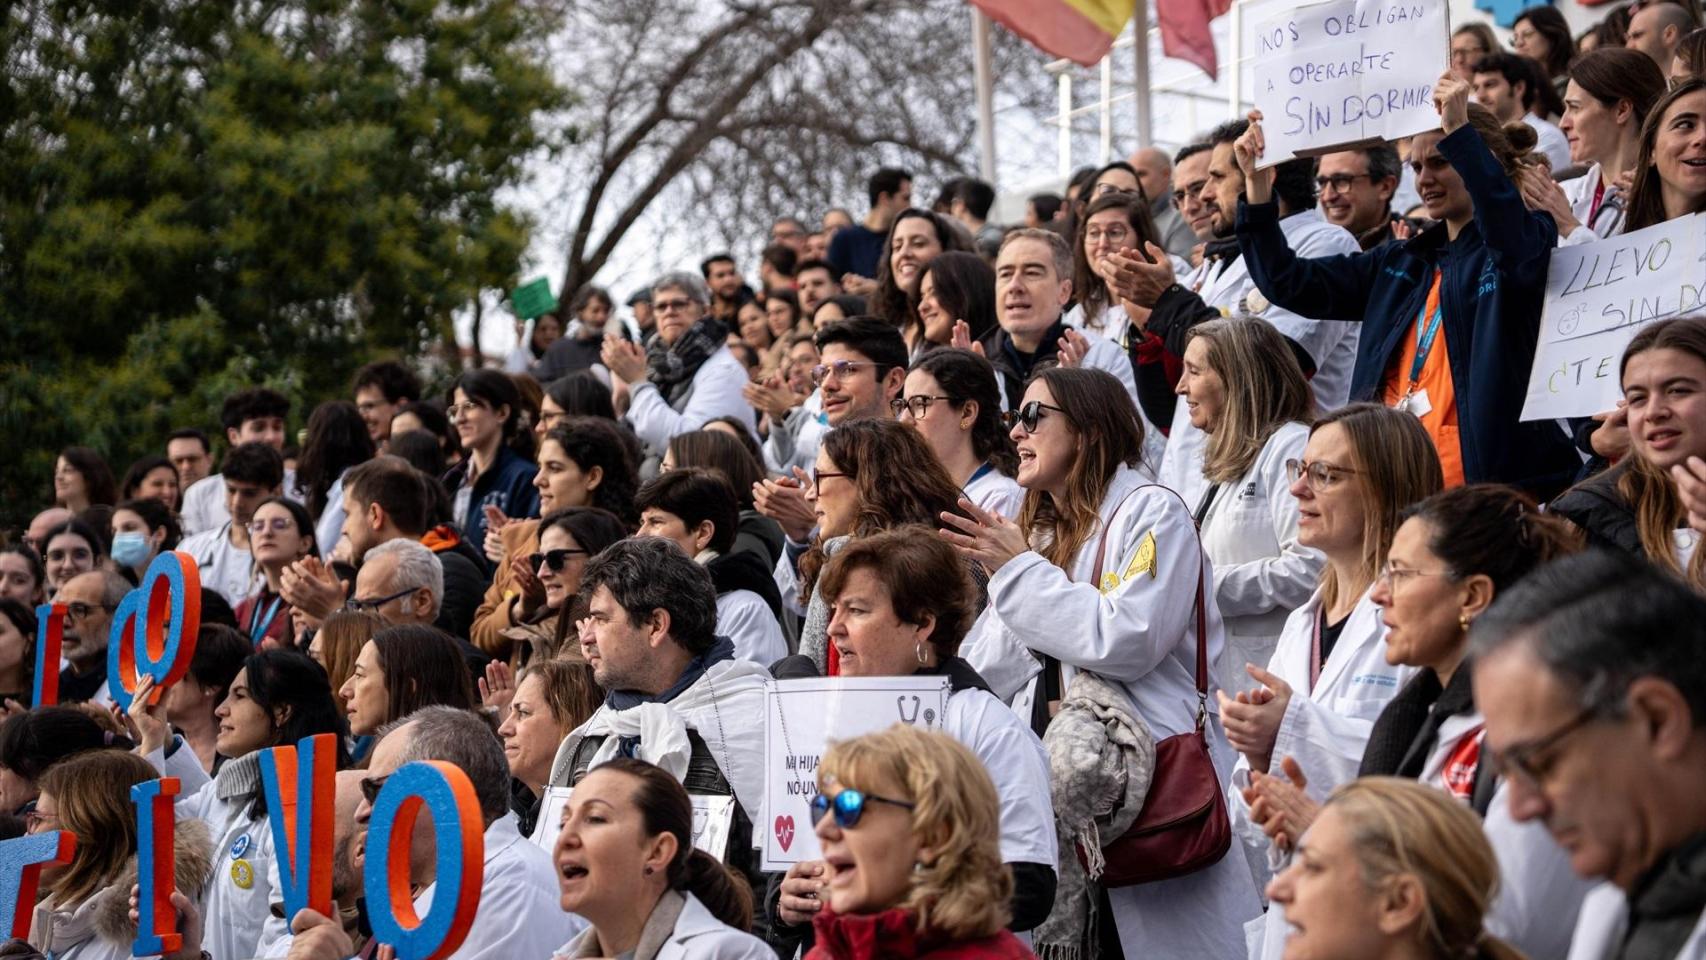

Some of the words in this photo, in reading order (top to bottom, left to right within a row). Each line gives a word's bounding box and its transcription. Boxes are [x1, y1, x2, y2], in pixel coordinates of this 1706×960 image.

[1324, 5, 1424, 36] OBLIGAN
[1288, 51, 1395, 85] OPERARTE
[1283, 96, 1331, 136] SIN
[1560, 237, 1673, 299] LLEVO
[1601, 296, 1661, 327] SIN
[785, 755, 797, 770] MI
[787, 781, 800, 796] NO
